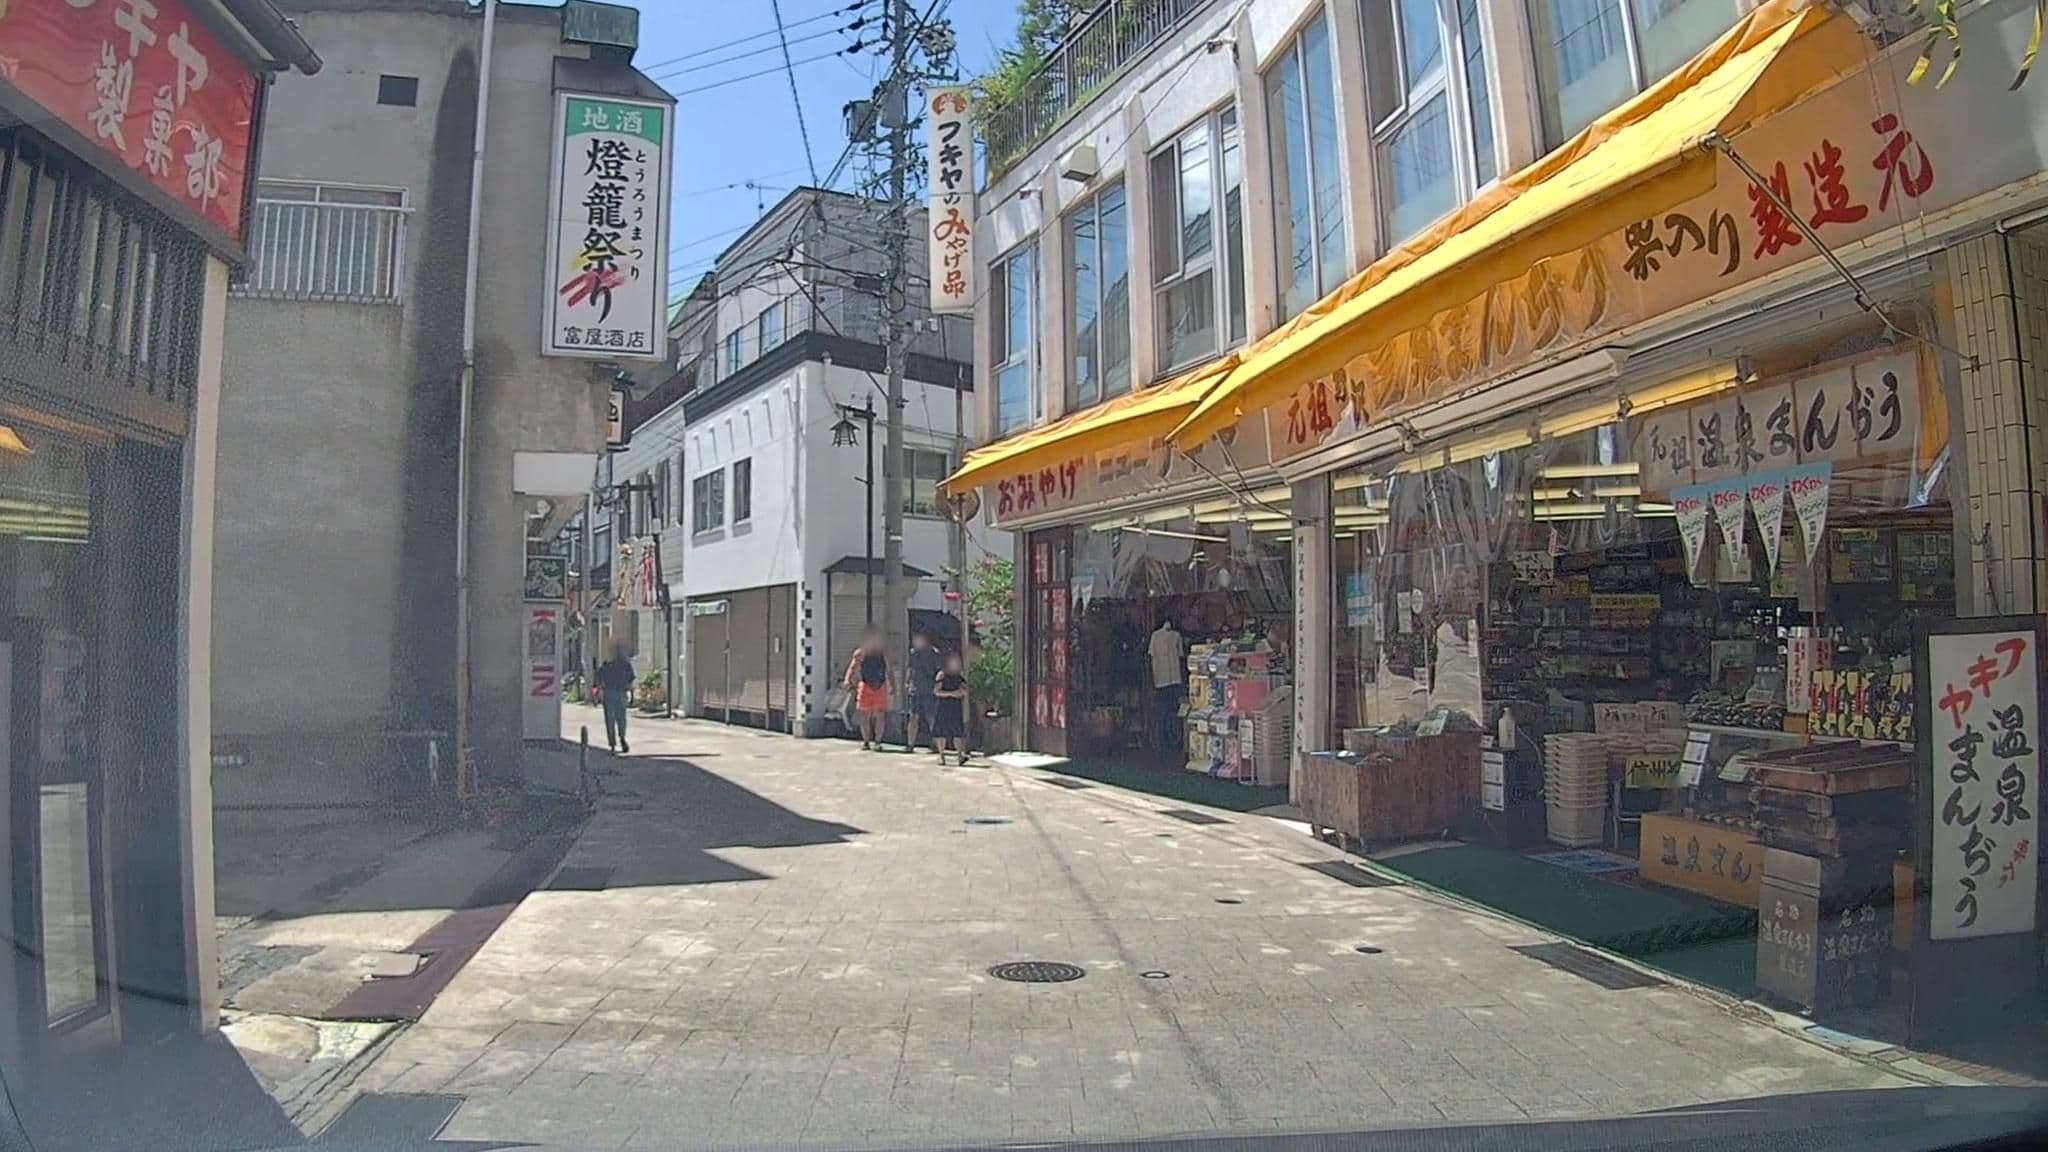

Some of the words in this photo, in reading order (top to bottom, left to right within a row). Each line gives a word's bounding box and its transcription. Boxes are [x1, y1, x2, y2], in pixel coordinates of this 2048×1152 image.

[64, 0, 209, 106] キヤ
[87, 40, 224, 214] 製菓部
[581, 106, 643, 134] 地酒
[579, 138, 634, 324] 燈籠祭り
[629, 149, 648, 281] とうろうまつり
[1747, 112, 1934, 261] 製造元
[563, 325, 645, 348] 富屋酒店
[997, 456, 1084, 516] おみやげ
[1938, 637, 2028, 729] フキヤ
[1942, 724, 1995, 928] まんぢう
[1987, 704, 2033, 826] 温泉
